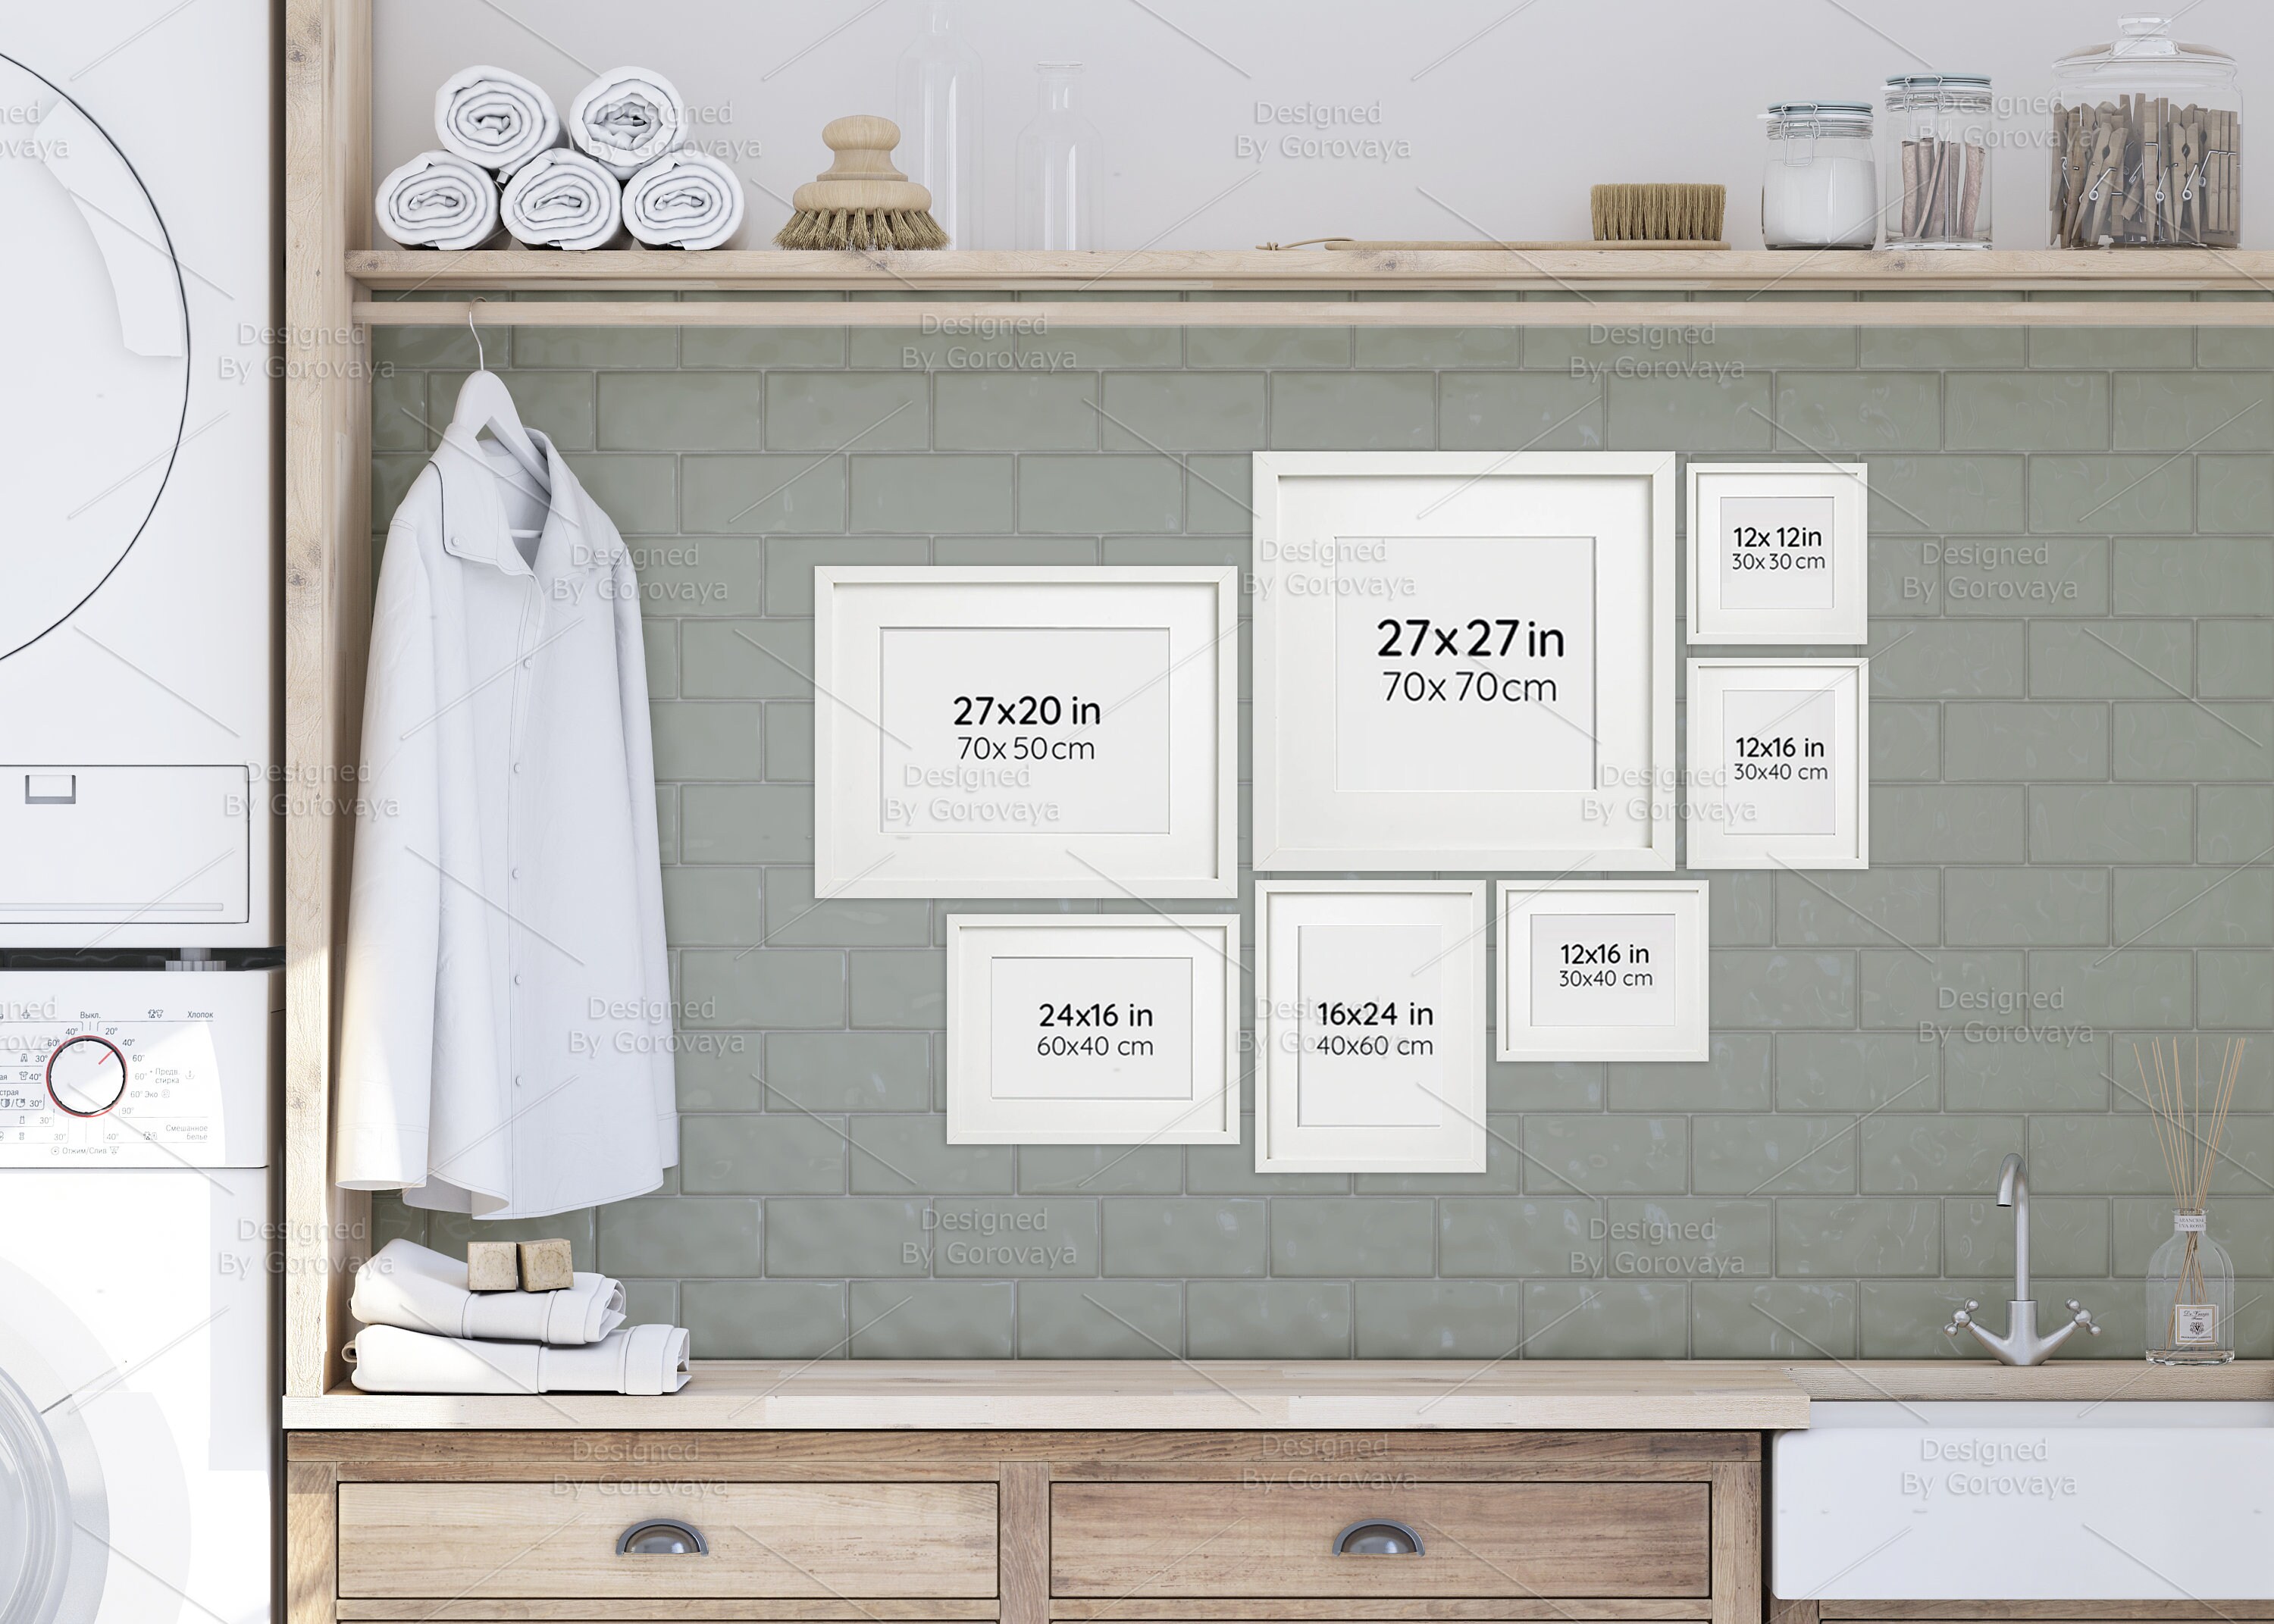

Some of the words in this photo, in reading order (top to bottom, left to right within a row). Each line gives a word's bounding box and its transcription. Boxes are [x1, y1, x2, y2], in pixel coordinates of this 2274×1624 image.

[954, 696, 1061, 726] 27x20
[1072, 696, 1101, 726] in
[1736, 737, 1796, 758] 12x16
[1805, 737, 1825, 758] in
[1734, 763, 1792, 781] 30x40
[1798, 766, 1828, 781] cm
[1561, 943, 1621, 965] 12x16
[1630, 943, 1649, 965] in
[1559, 969, 1617, 987] 30x40
[1623, 972, 1652, 987] cm
[1039, 1003, 1119, 1027] 24x16
[1129, 1003, 1153, 1027] in
[1317, 1002, 1398, 1026] 16x24
[1410, 1002, 1433, 1026] in
[105, 1027, 118, 1035] 20°
[1037, 1036, 1109, 1056] 60x40
[1117, 1039, 1153, 1056] cm
[1317, 1035, 1389, 1056] 40x60
[1397, 1039, 1433, 1056] cm
[62, 1147, 108, 1155] Отжим/Слив
